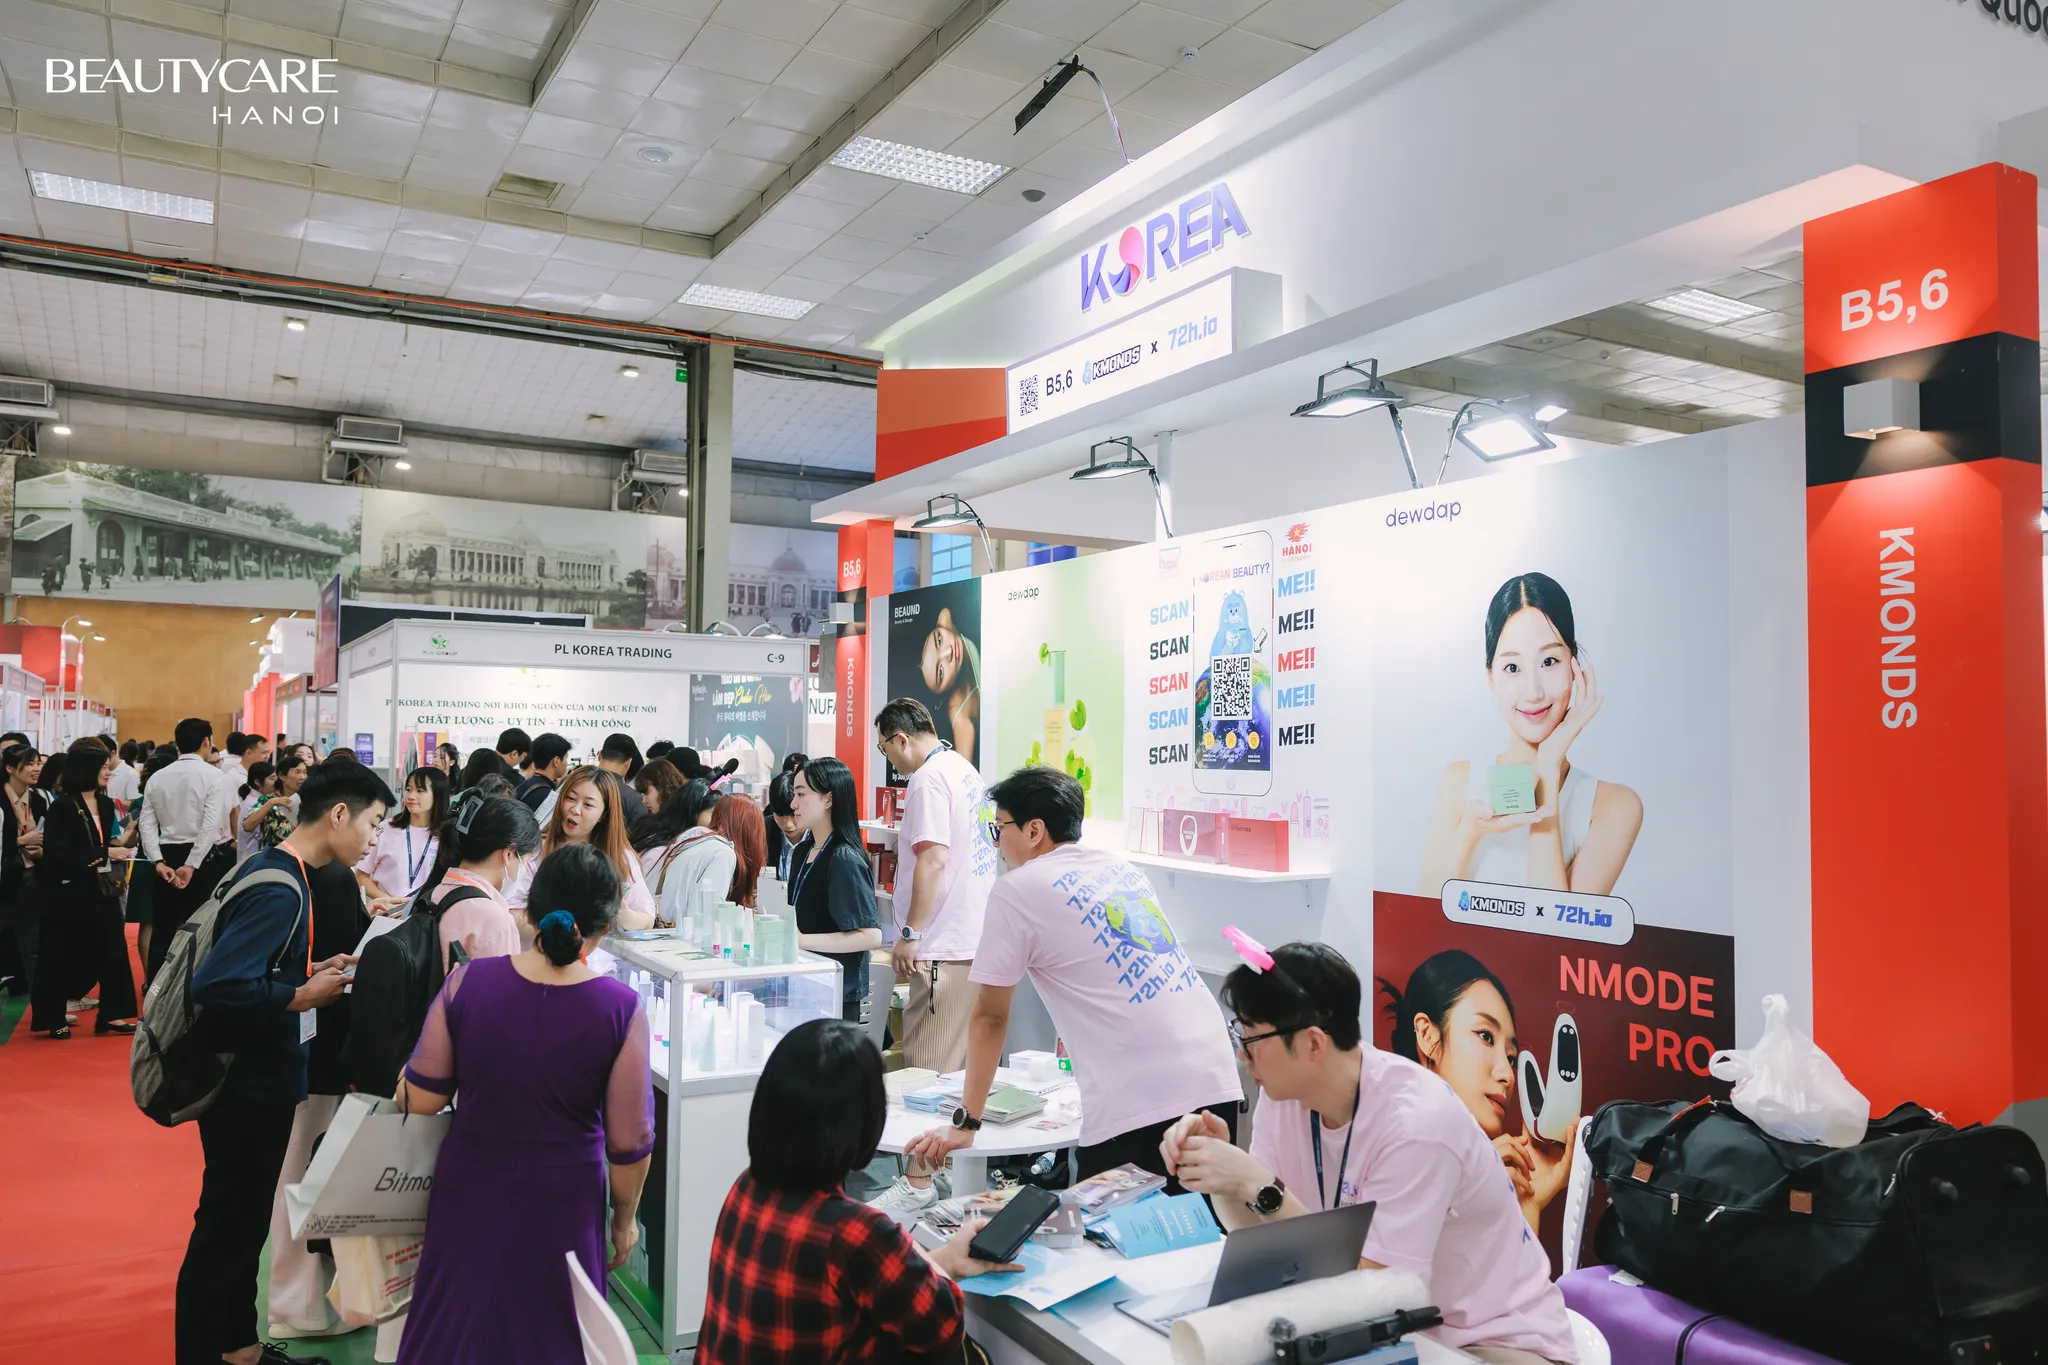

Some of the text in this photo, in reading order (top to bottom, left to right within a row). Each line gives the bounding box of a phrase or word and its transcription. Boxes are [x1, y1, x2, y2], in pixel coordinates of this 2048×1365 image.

[1081, 182, 1251, 314] KOREA
[1840, 268, 1949, 333] B5,6
[1046, 370, 1073, 396] B5,6
[1092, 345, 1141, 380] KMONDS
[1168, 316, 1218, 350] 72h.io
[1386, 501, 1462, 528] dewdap
[1282, 543, 1312, 557] HANOI
[843, 560, 861, 577] B5,6
[1232, 562, 1270, 578] BEAUTY?
[1007, 586, 1040, 601] dewdap
[1277, 569, 1316, 598] ME!!
[894, 604, 921, 618] BEAUND
[1150, 599, 1189, 625] SCAN
[1278, 608, 1315, 635] ME!!
[1879, 526, 1918, 729] KMONDS
[554, 644, 672, 659] PL KOREA TRADING
[767, 653, 785, 663] C-9
[1150, 635, 1189, 660] SCAN
[1277, 647, 1315, 673] ME!!
[1150, 672, 1189, 695] SCAN
[436, 700, 481, 709] TRADING
[846, 657, 854, 738] KMONDS
[1277, 684, 1315, 709] ME!!
[507, 717, 523, 726] UY
[1149, 707, 1188, 730] SCAN
[1278, 723, 1315, 746] ME!!
[1149, 744, 1188, 765] SCAN
[1470, 895, 1526, 916] KMONDS
[1554, 904, 1612, 928] 72h.io
[1128, 962, 1176, 1005] 72h.io
[1560, 955, 1715, 1019] NMODE
[1629, 1022, 1717, 1077] PRO
